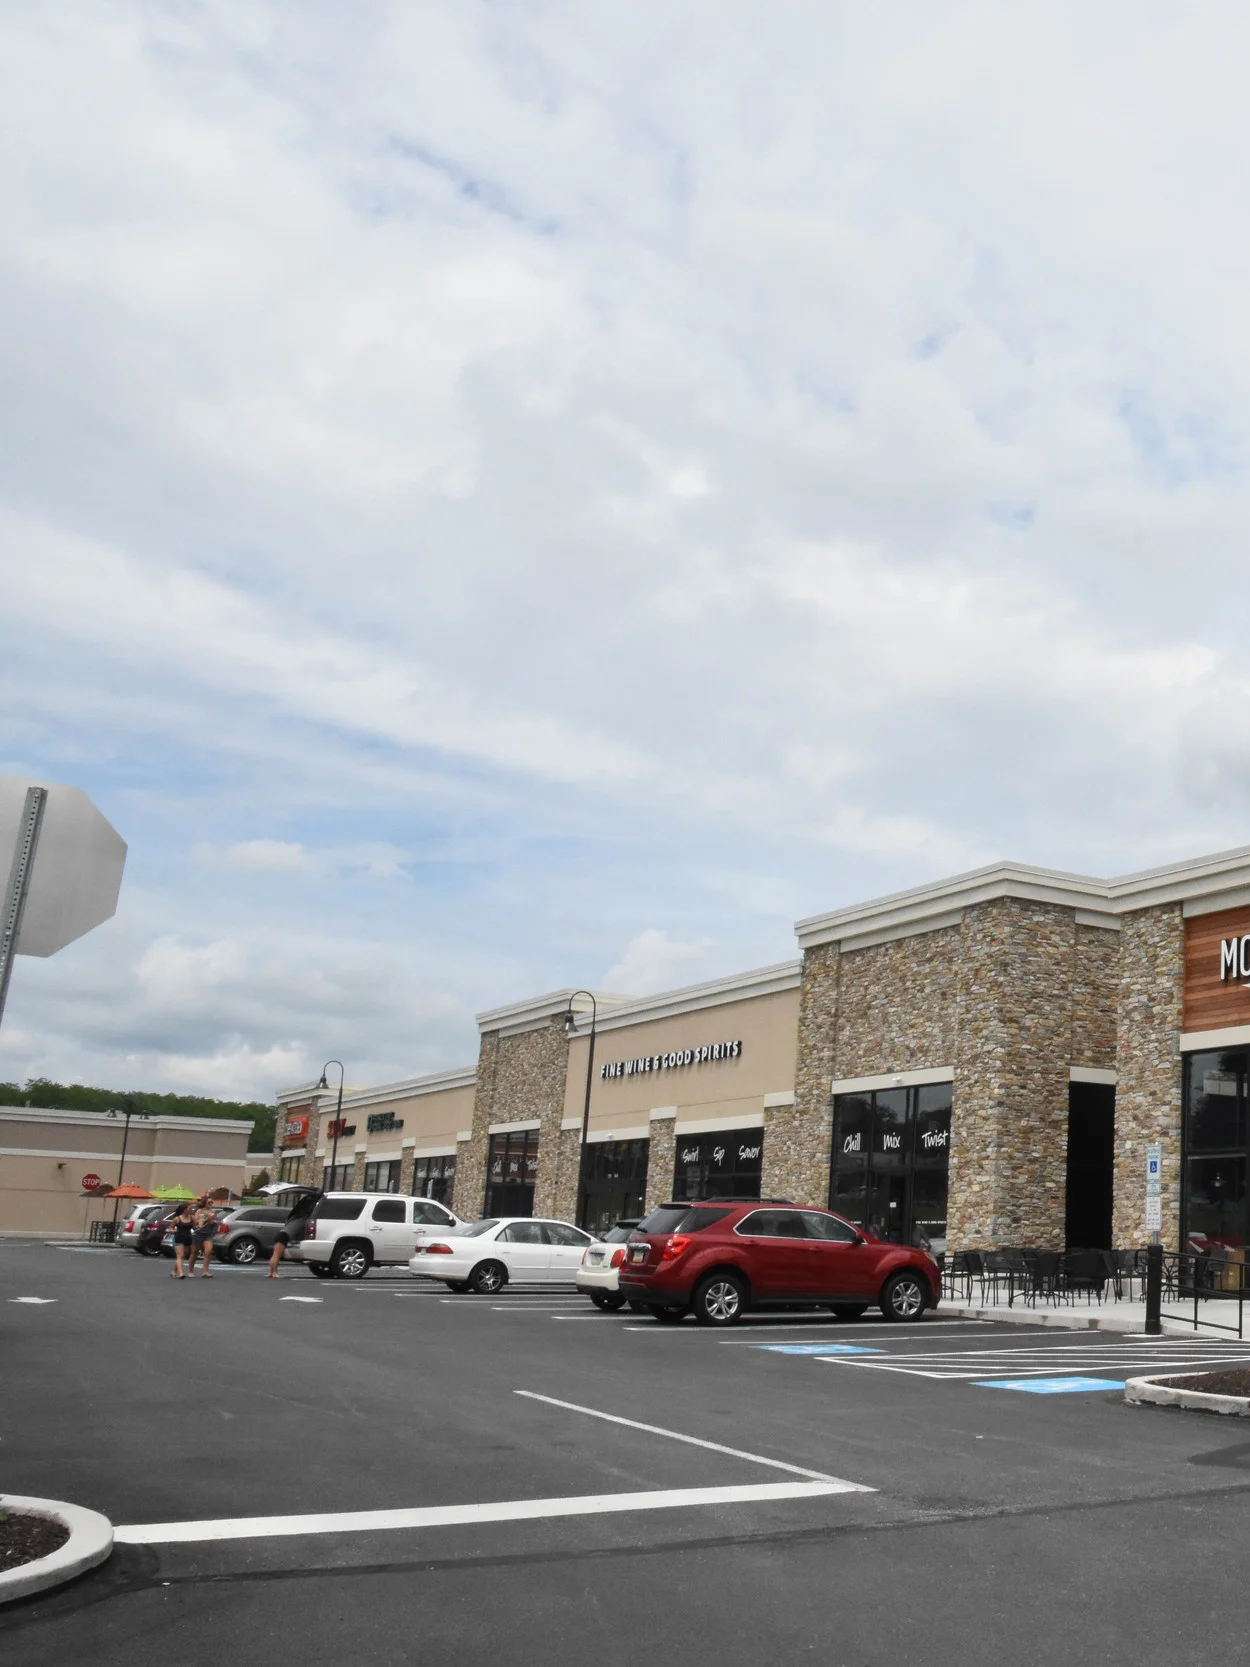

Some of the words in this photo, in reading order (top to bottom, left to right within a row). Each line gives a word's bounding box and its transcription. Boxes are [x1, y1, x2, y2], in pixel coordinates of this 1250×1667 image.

[600, 1063, 622, 1078] FINE
[624, 1057, 650, 1075] WINE
[662, 1049, 692, 1068] GOOD
[694, 1040, 740, 1063] SPIRITS
[843, 1132, 861, 1153] Chill
[883, 1131, 901, 1151] Mix
[921, 1129, 949, 1149] Twist
[739, 1145, 760, 1160] Savor
[82, 1177, 100, 1187] STOP
